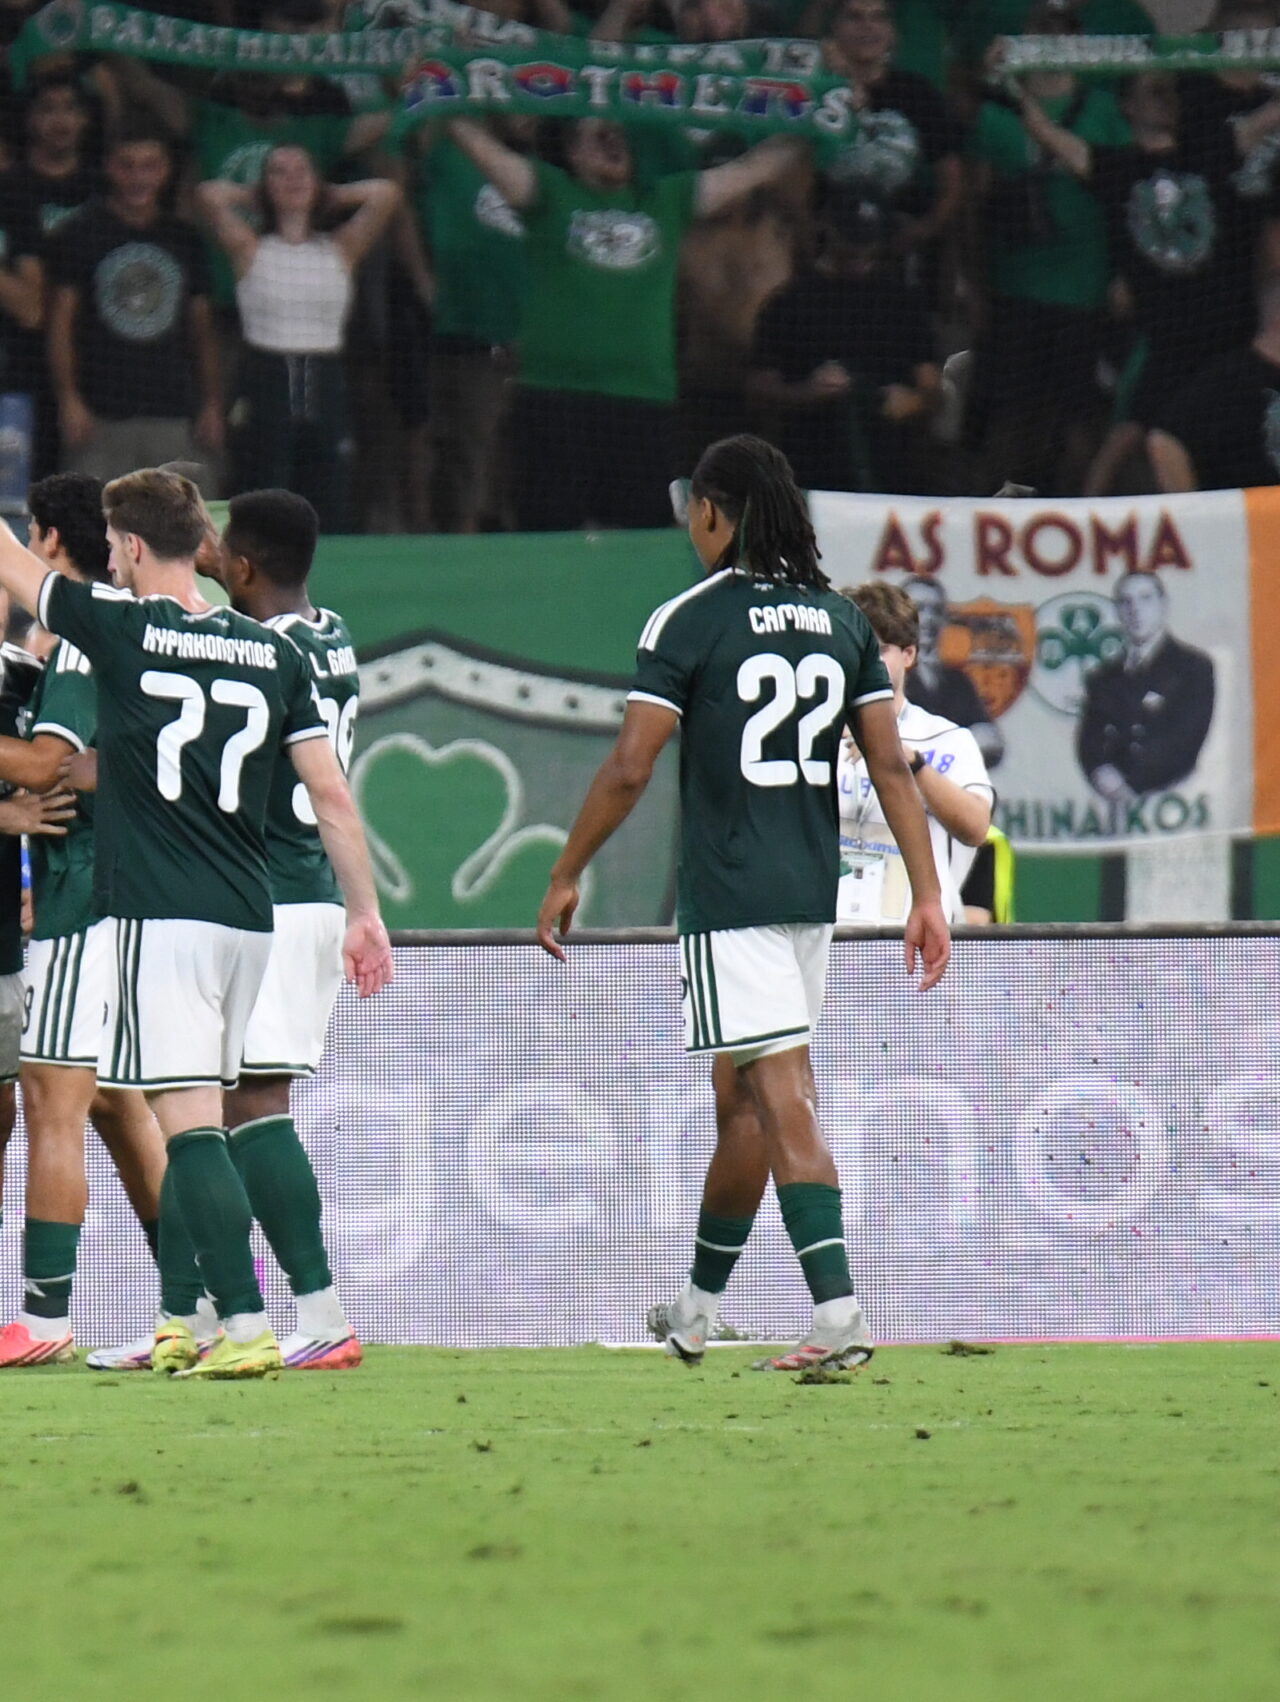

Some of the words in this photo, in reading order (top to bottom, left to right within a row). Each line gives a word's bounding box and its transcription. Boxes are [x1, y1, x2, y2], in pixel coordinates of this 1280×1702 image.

[873, 510, 945, 575] AS
[974, 510, 1193, 577] ROMA
[748, 603, 832, 635] CAMARA
[140, 670, 270, 814] 77
[736, 652, 846, 787] 22
